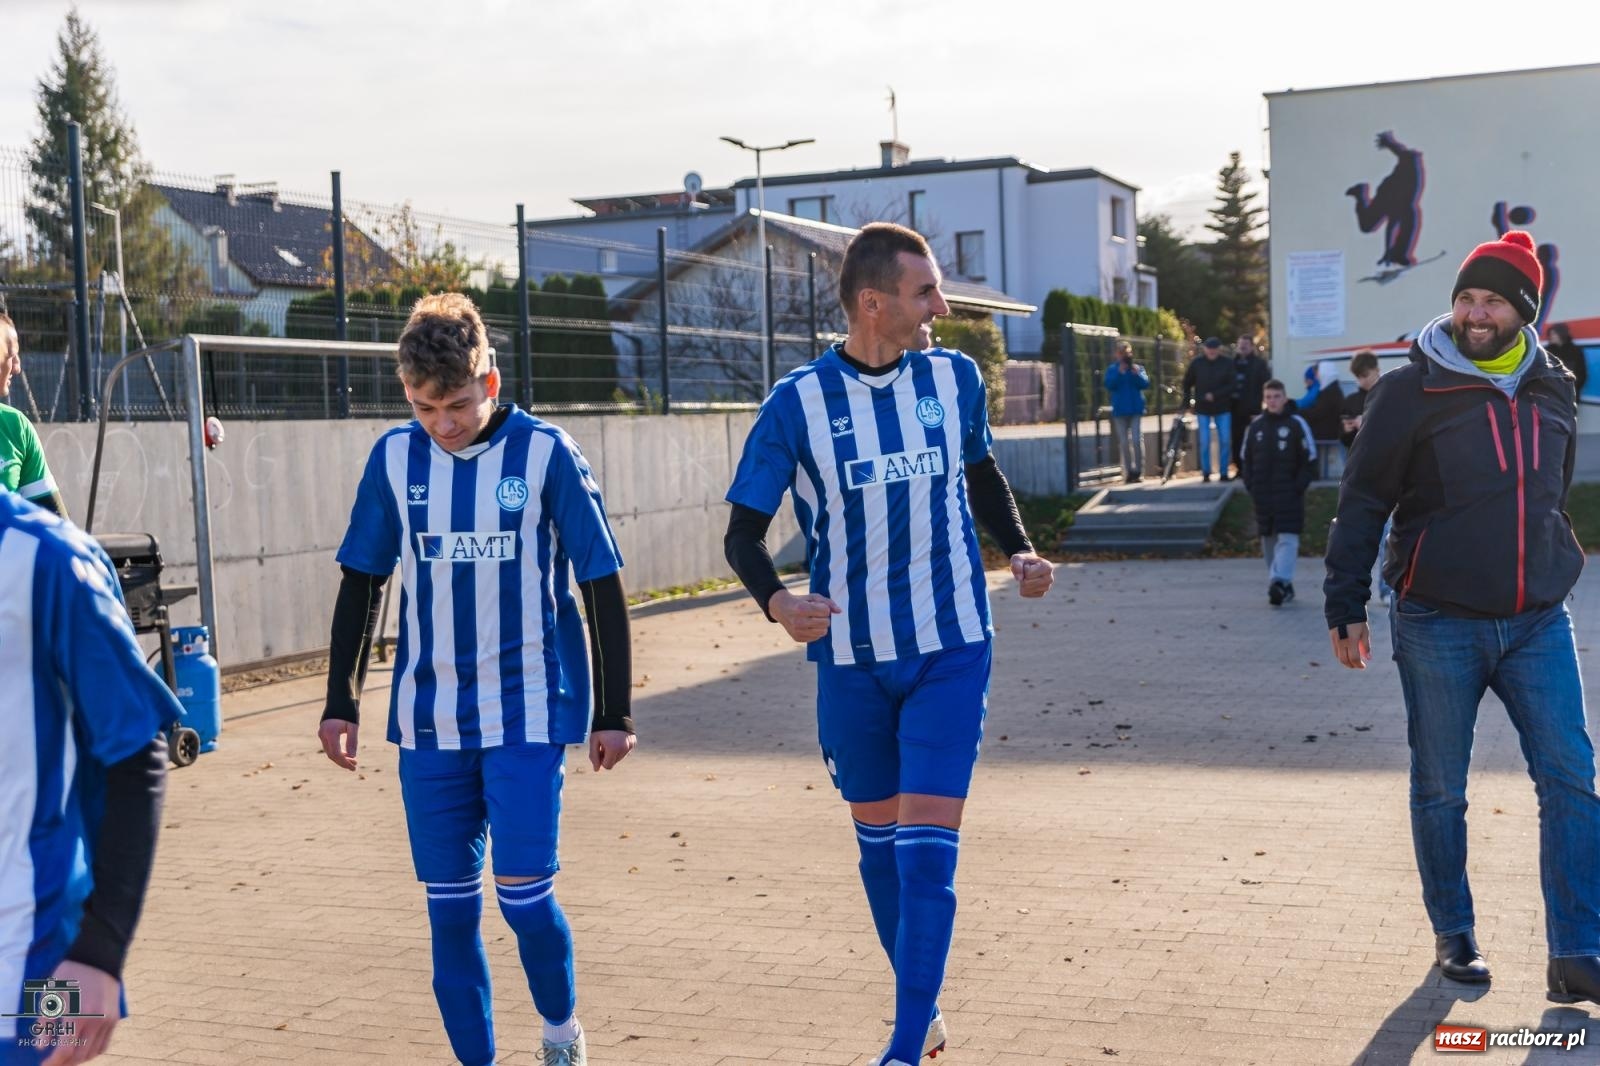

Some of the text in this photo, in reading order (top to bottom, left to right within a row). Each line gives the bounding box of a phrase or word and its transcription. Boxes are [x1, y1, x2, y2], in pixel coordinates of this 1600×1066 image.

[920, 400, 941, 417] LKS
[883, 451, 938, 481] AMT
[501, 480, 525, 499] LKS
[450, 535, 511, 558] AMT
